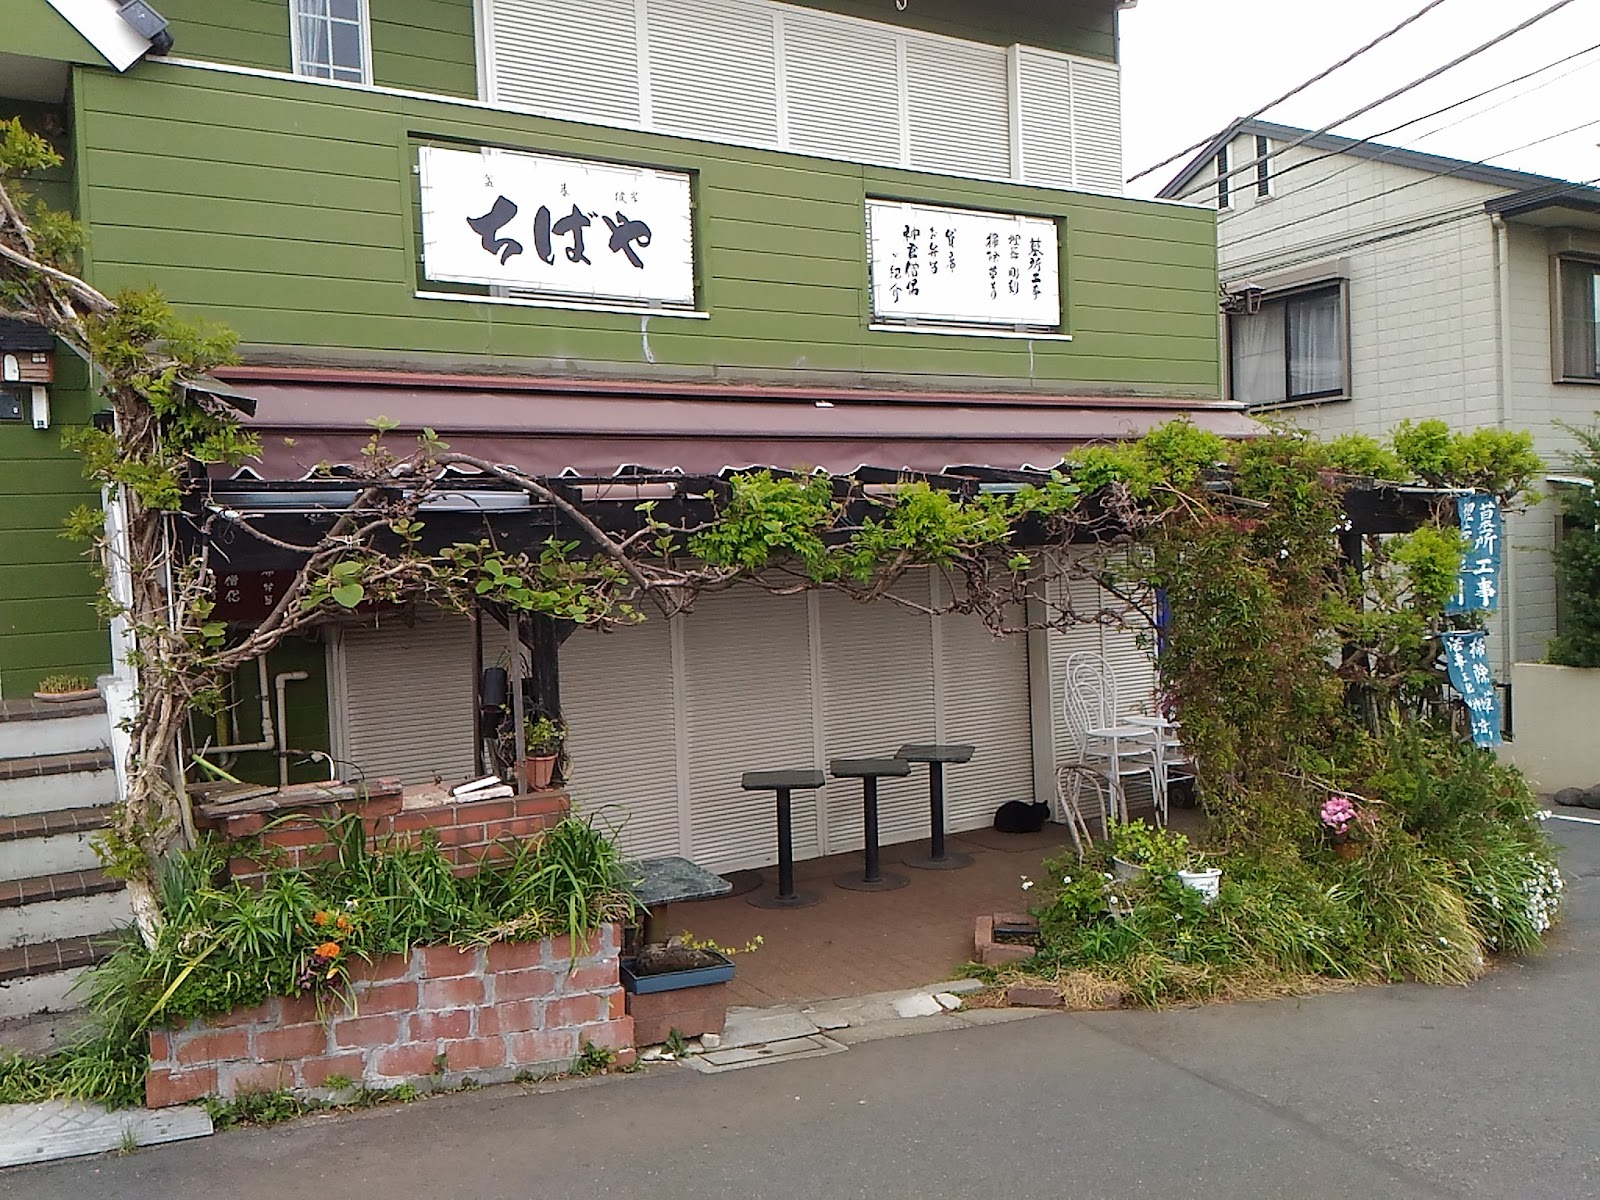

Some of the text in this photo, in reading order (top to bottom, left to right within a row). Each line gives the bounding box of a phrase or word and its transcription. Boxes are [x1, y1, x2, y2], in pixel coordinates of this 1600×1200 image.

[466, 195, 652, 269] ちばや
[928, 226, 939, 274] お弁当
[1028, 237, 1044, 300] 墓所工事
